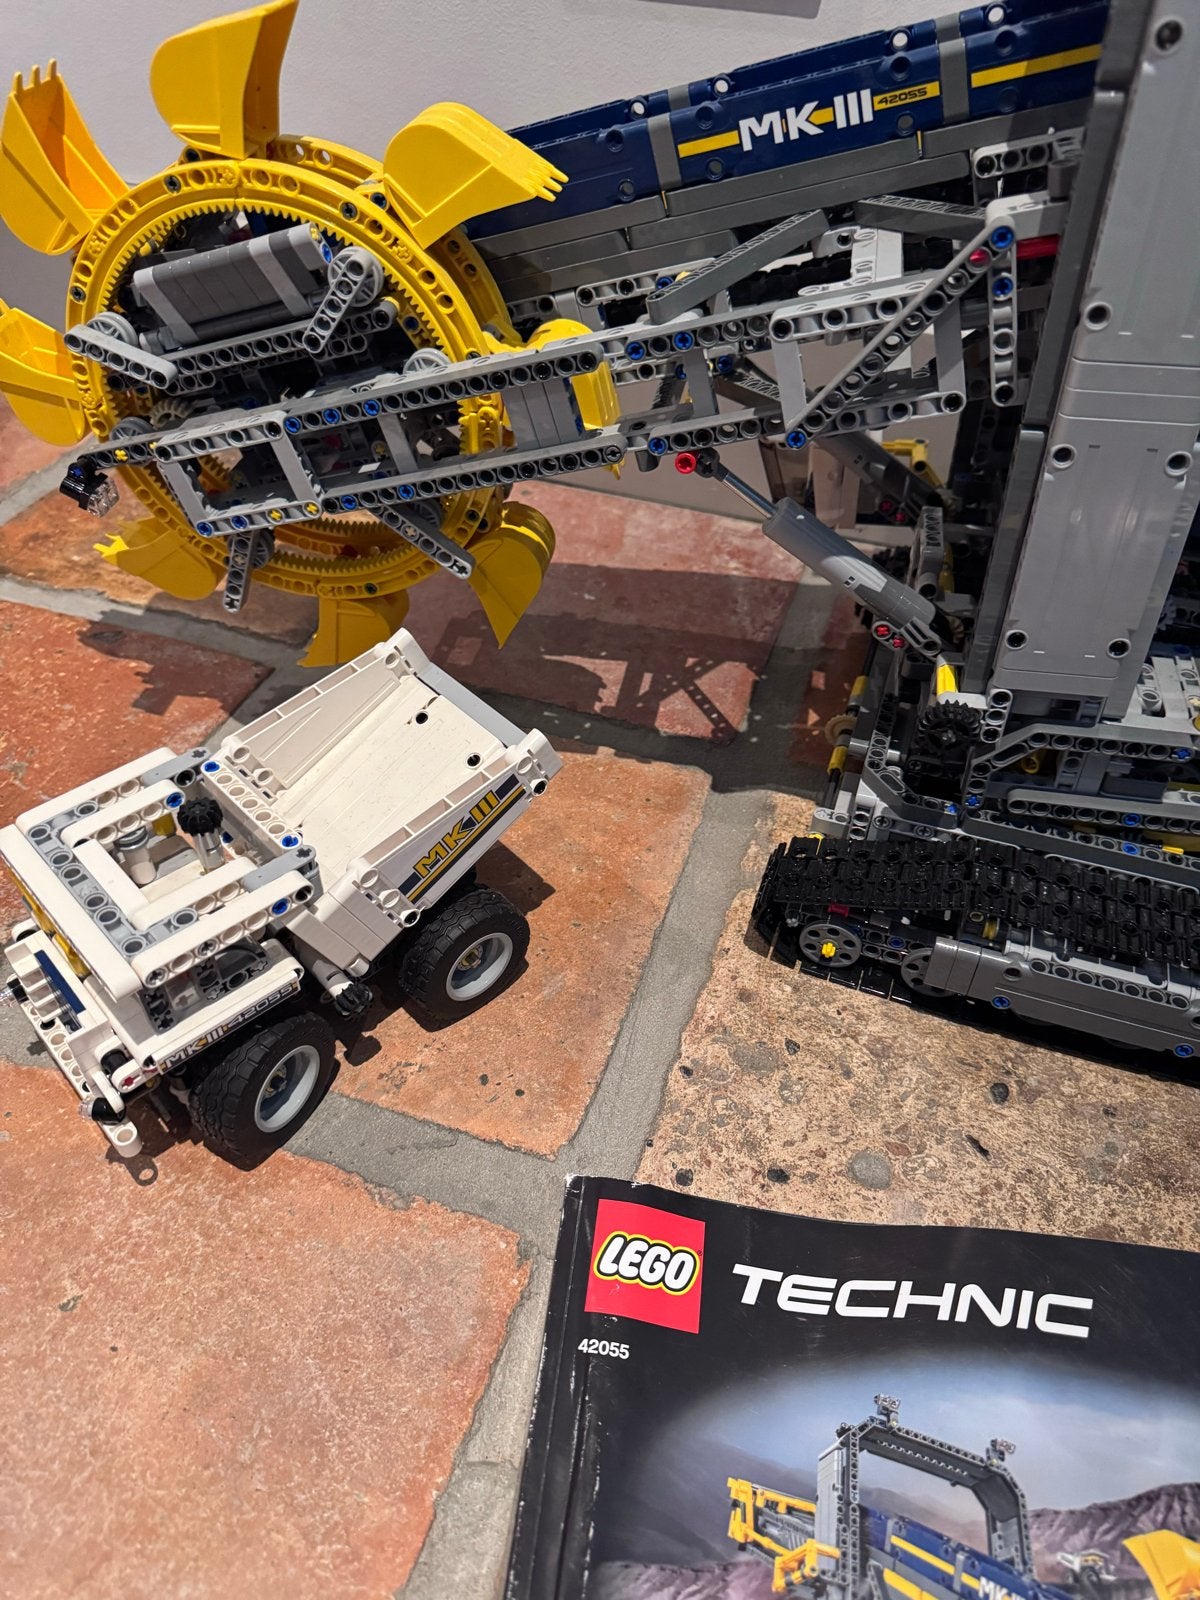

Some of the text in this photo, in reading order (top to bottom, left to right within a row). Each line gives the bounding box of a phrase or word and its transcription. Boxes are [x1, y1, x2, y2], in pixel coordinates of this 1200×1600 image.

[877, 87, 928, 106] 42055
[227, 986, 293, 1028] 42055
[594, 1231, 700, 1295] LEGO
[732, 1263, 1094, 1338] TECHNIC
[577, 1338, 630, 1360] 42055
